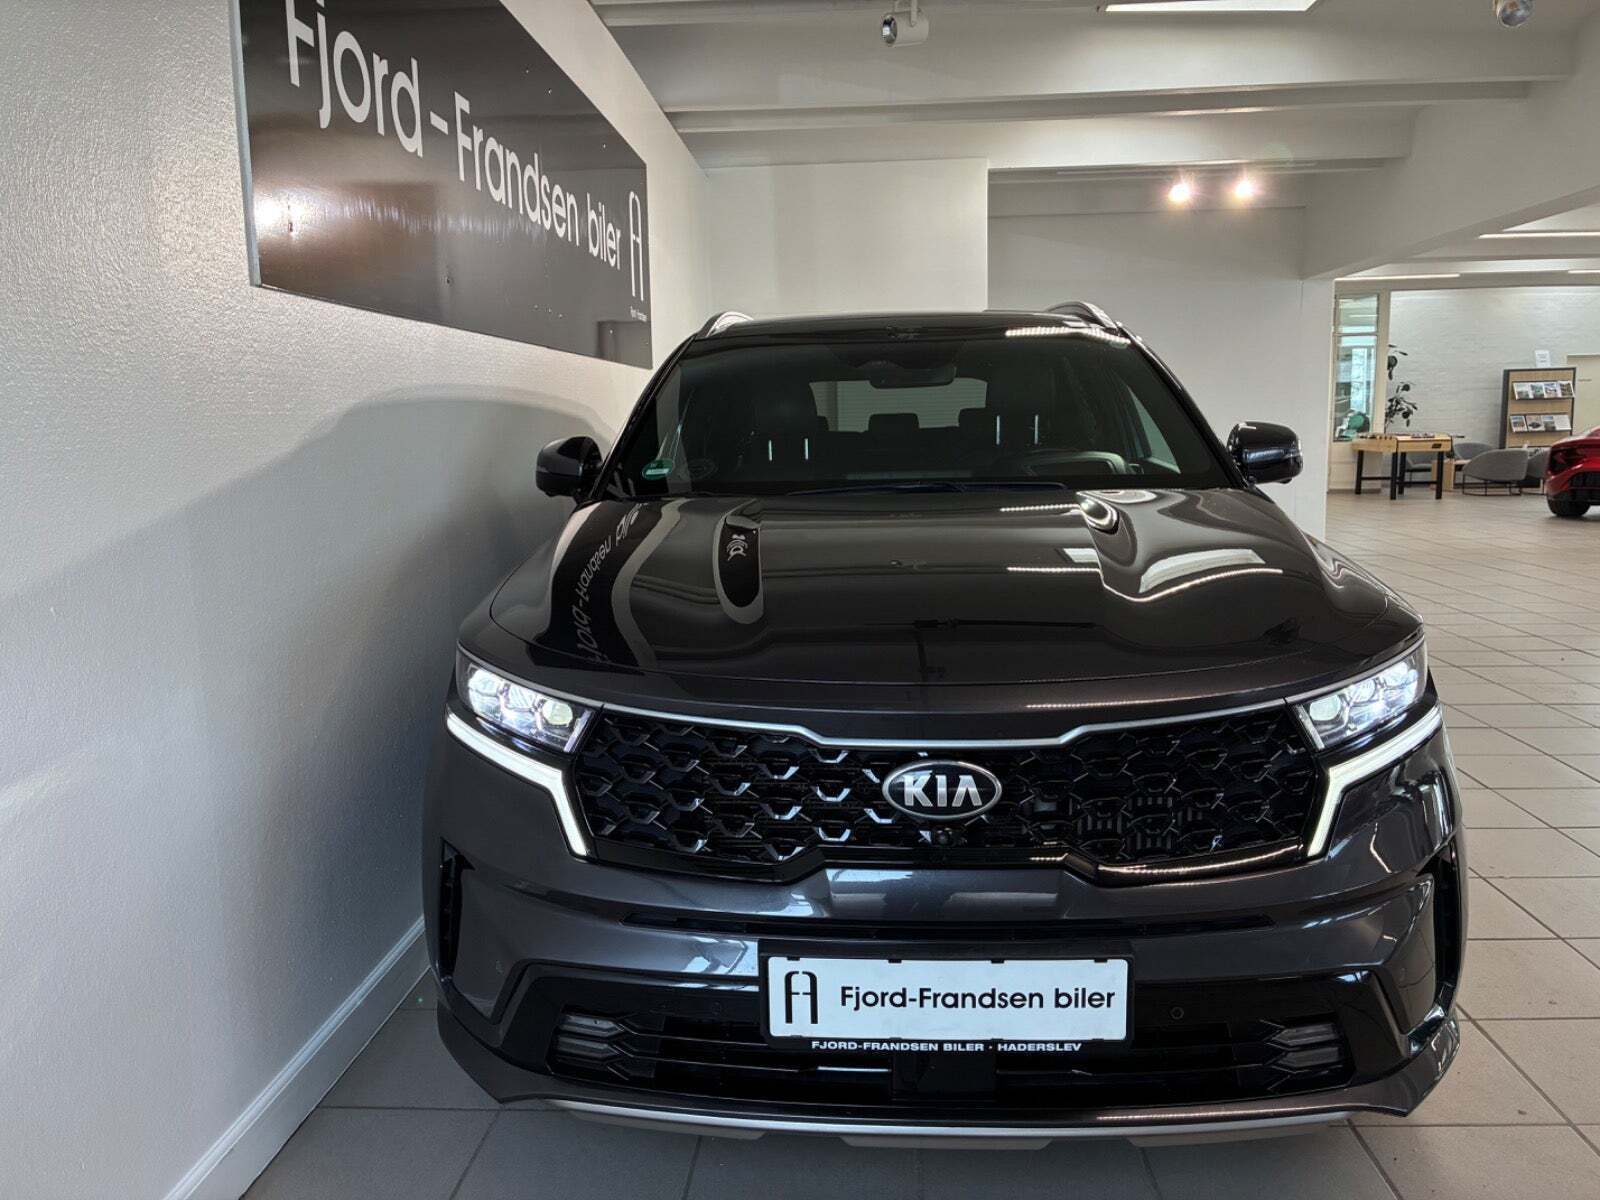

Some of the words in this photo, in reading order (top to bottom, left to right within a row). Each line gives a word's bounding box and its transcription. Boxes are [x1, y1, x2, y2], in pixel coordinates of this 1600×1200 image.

[586, 191, 621, 271] biler
[902, 774, 983, 808] KIA
[840, 986, 1044, 1011] Fjord-Frandsen
[1054, 987, 1115, 1009] biler
[811, 1041, 939, 1052] FJORD-FRANDSEN
[943, 1042, 985, 1052] BILER
[997, 1042, 1082, 1052] HADERSLEV
